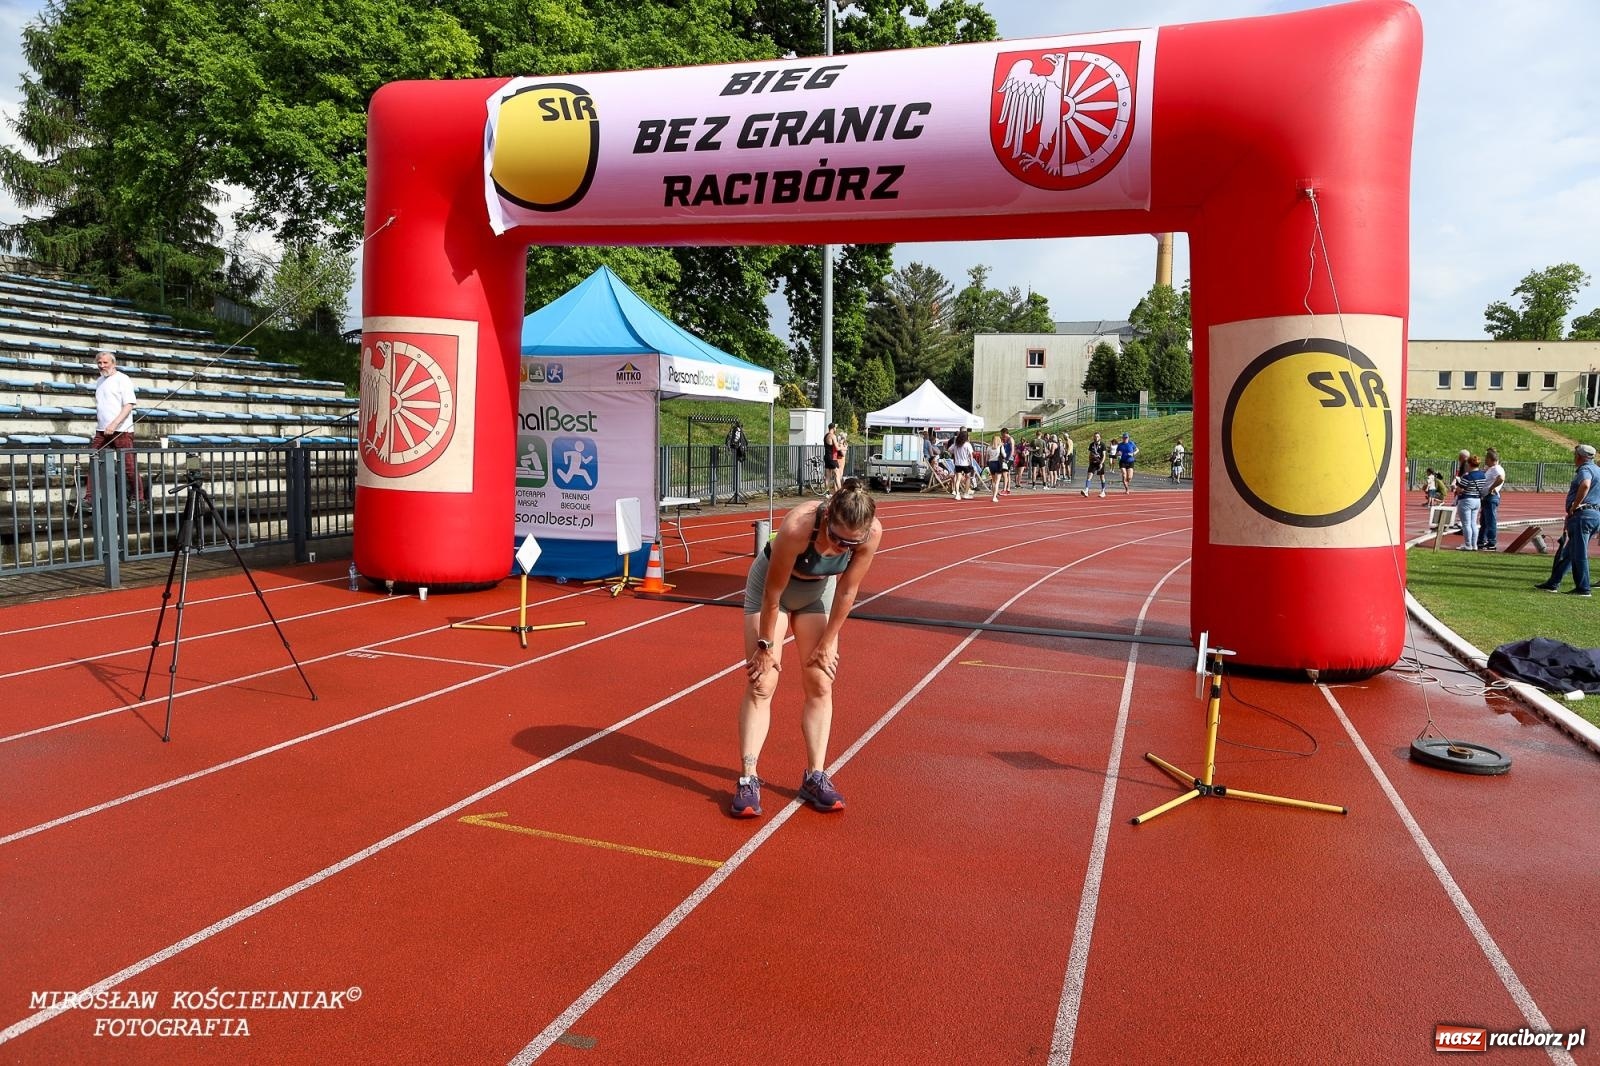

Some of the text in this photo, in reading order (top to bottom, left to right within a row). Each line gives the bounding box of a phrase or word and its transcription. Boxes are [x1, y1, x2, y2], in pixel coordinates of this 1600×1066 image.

[719, 64, 848, 97] BIEG
[537, 95, 599, 122] SIR
[632, 101, 933, 154] BEZ GRANIC
[662, 158, 906, 208] RACIBÓRZ
[616, 371, 642, 381] MITKO
[1307, 370, 1391, 408] SIR
[561, 492, 590, 501] TRENINGI
